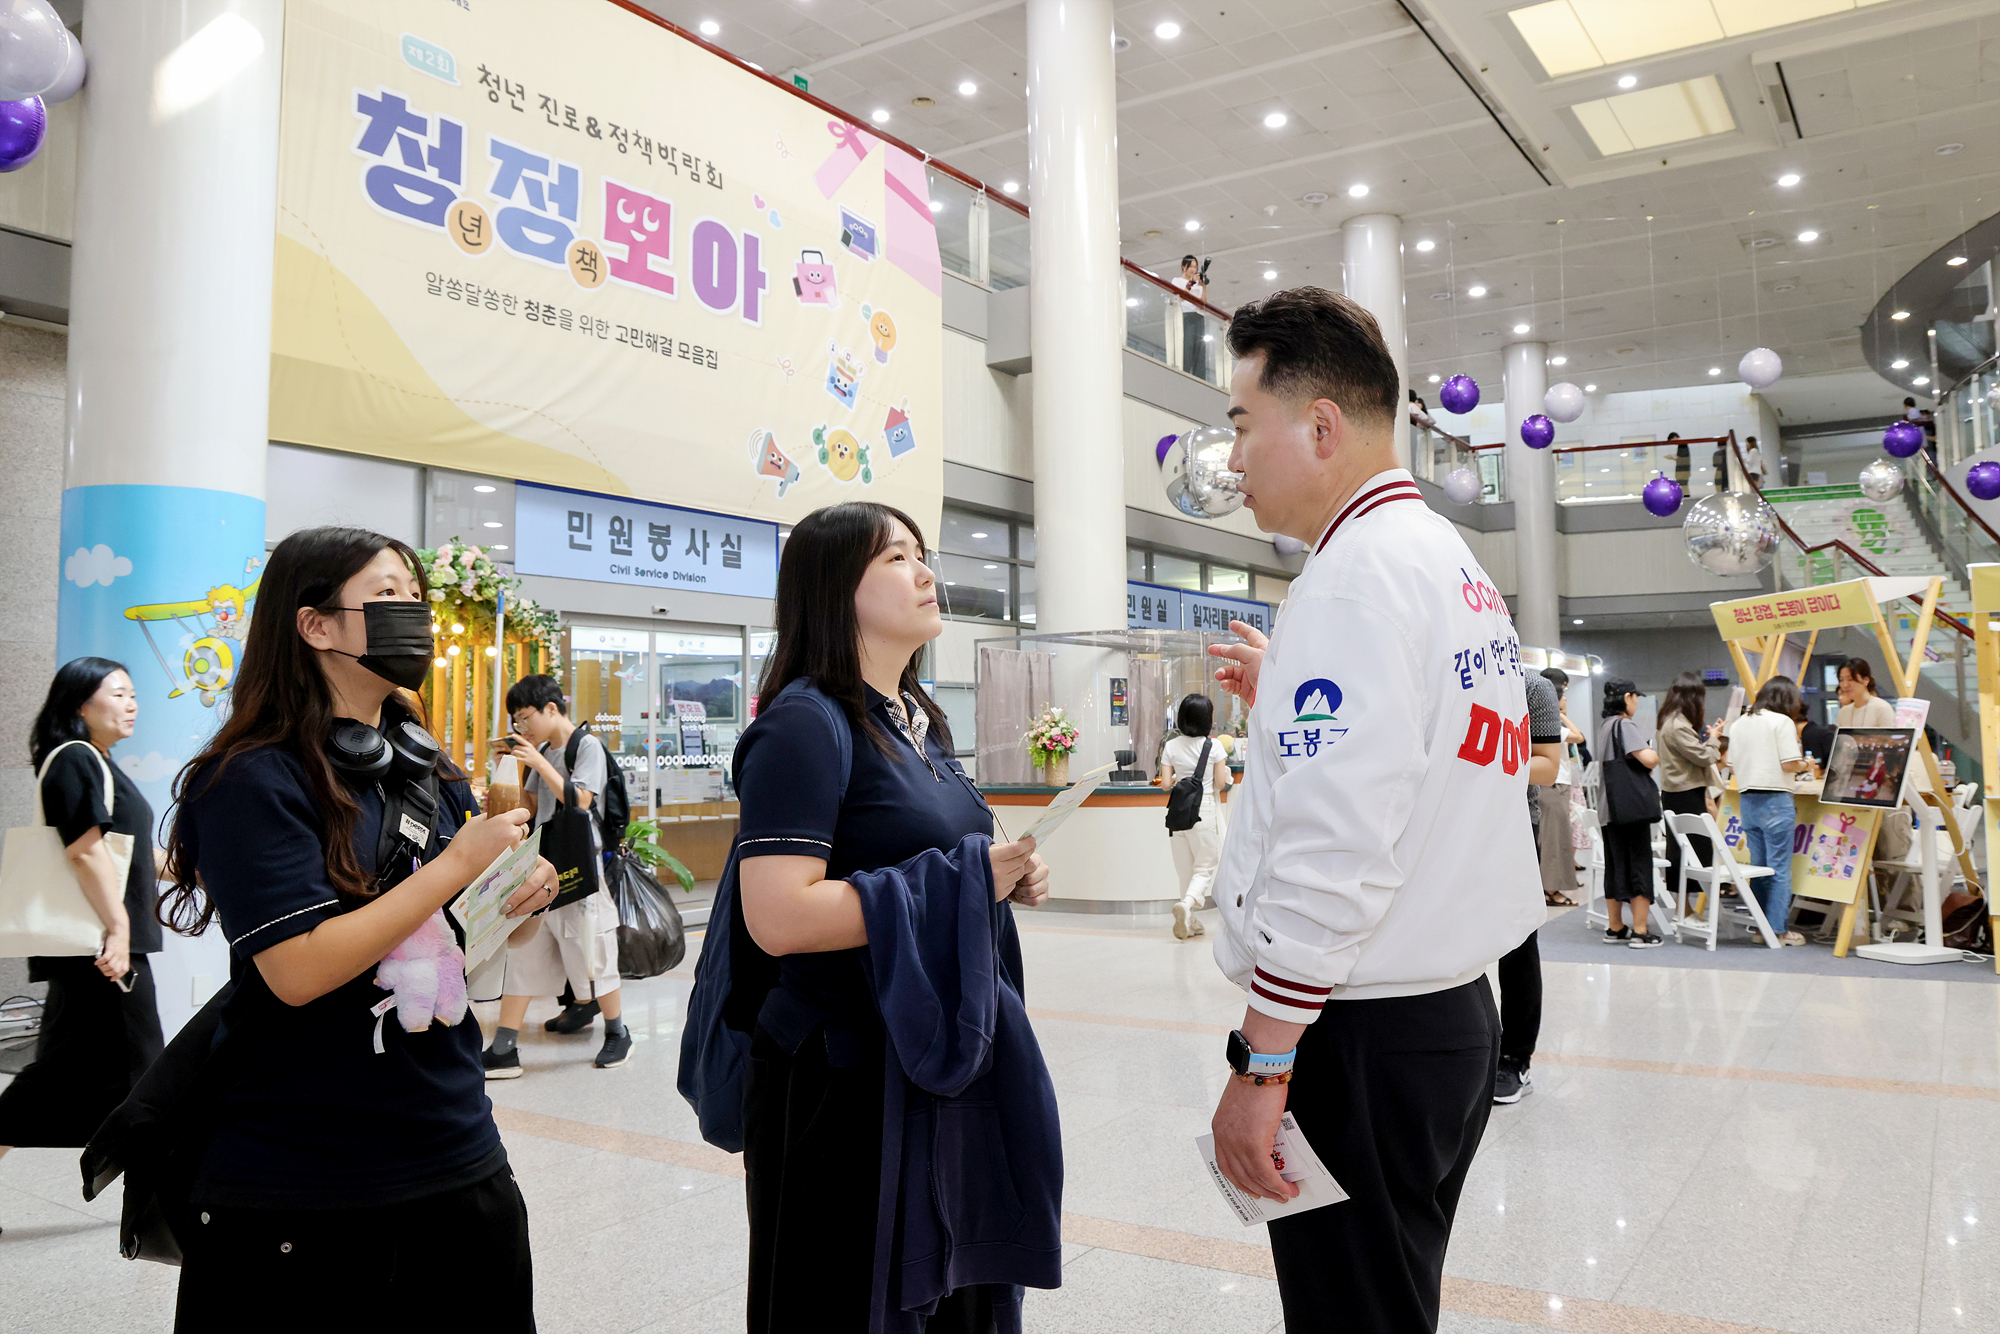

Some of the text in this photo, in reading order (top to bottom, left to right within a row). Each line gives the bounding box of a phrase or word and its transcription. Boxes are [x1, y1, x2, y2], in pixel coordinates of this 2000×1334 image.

[407, 44, 451, 74] 제2회
[476, 63, 526, 113] 청년
[425, 271, 719, 371] 알쏭달쏭한 청춘을 위한 고민해결 모음집
[567, 510, 743, 570] 민원봉사실
[609, 564, 707, 583] Civil Service Division
[1733, 608, 1754, 624] 청년
[1776, 599, 1808, 617] 도봉이
[1806, 593, 1842, 614] 답이다
[1454, 648, 1487, 690] 같이
[594, 712, 623, 724] dobong
[681, 713, 706, 724] dobong
